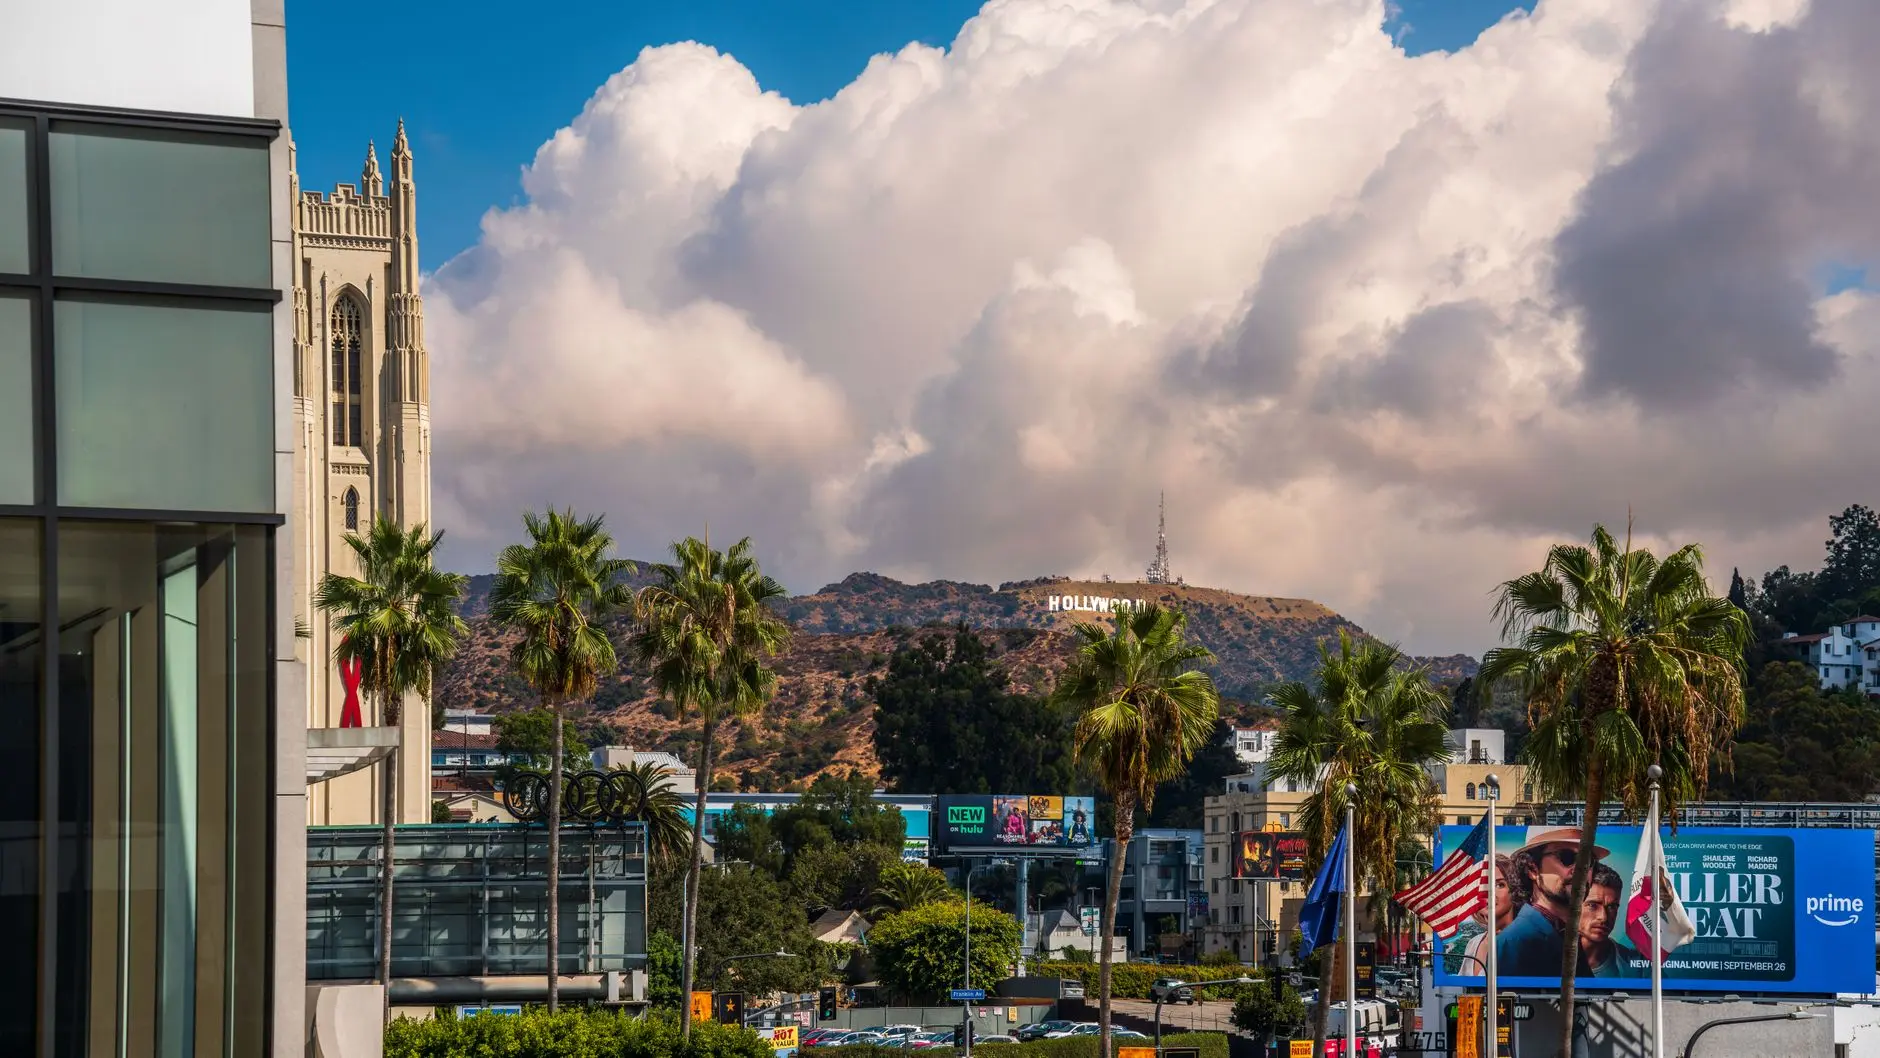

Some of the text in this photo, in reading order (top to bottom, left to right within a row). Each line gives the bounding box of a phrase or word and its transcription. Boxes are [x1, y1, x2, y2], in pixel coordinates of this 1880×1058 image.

[950, 809, 982, 821] NEW
[961, 825, 983, 833] hulu
[1673, 872, 1784, 905] LLER
[1806, 893, 1864, 915] prime
[1686, 907, 1762, 939] EAT
[1630, 959, 1650, 968] NEW
[1692, 960, 1719, 969] MOVIE
[1723, 961, 1773, 971] SEPTEMBER
[1774, 962, 1786, 971] 26
